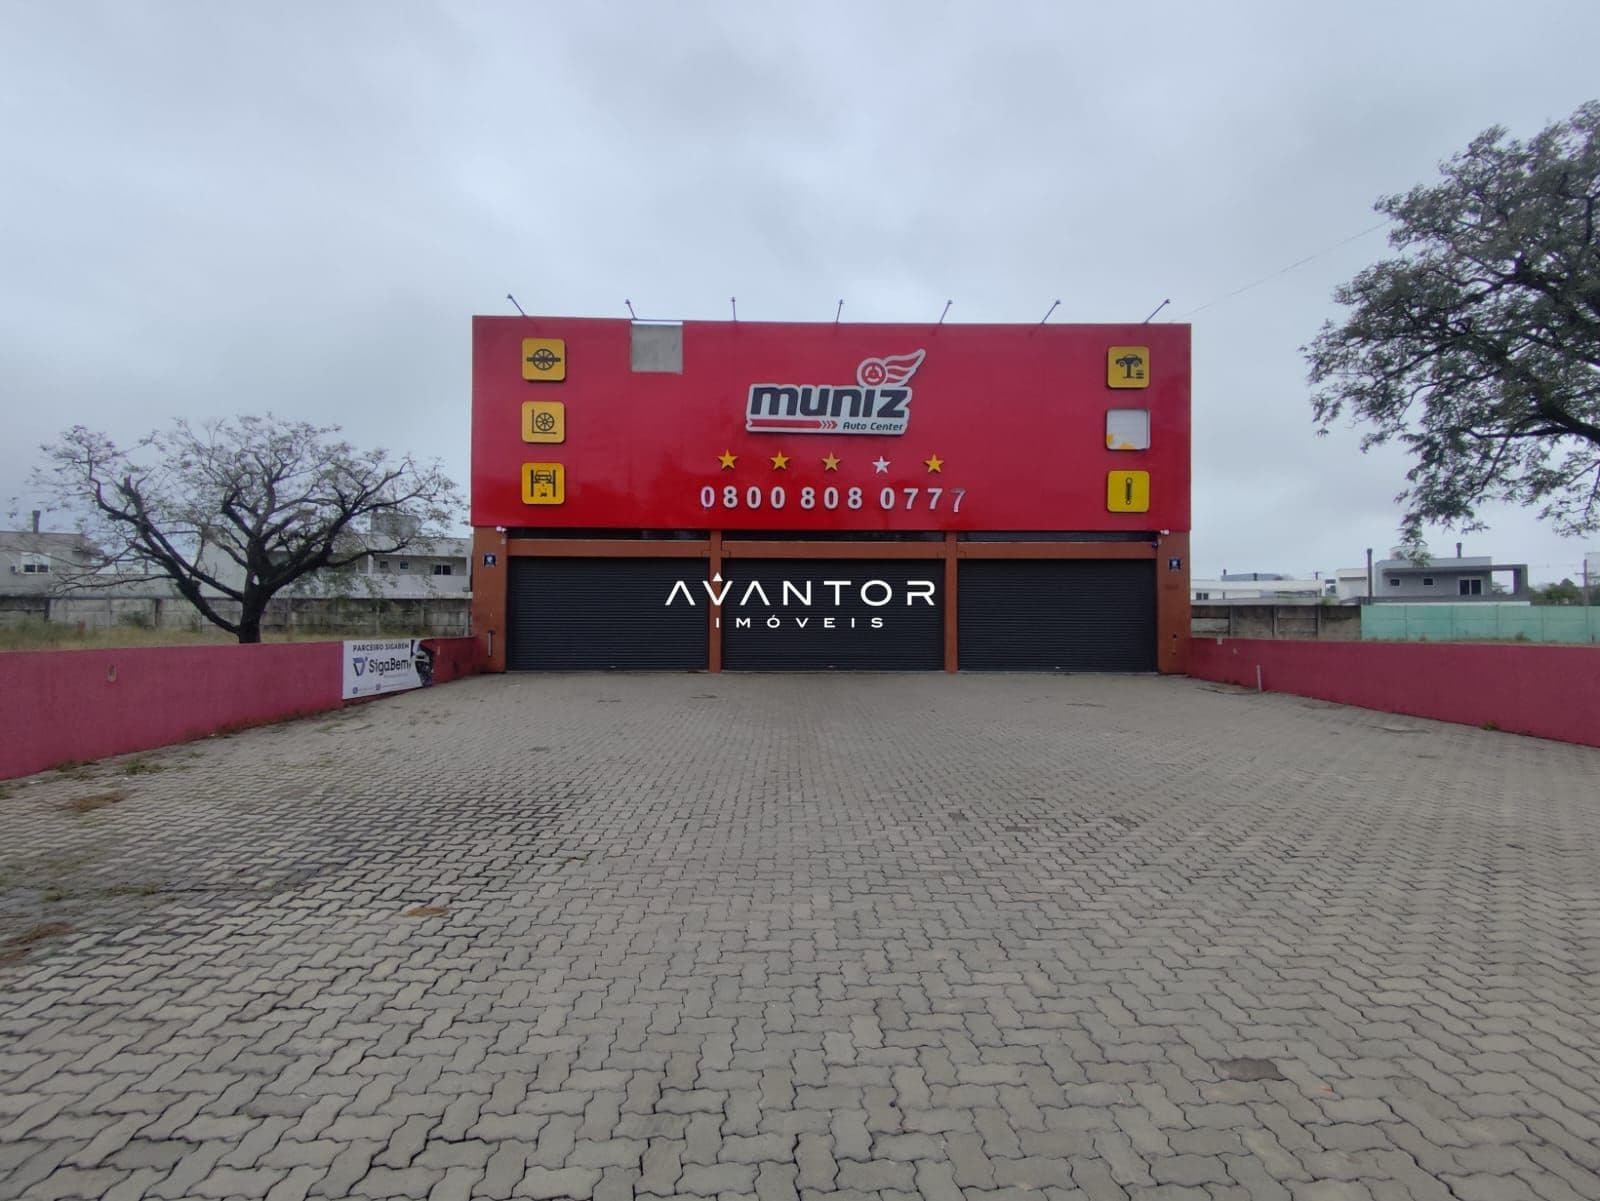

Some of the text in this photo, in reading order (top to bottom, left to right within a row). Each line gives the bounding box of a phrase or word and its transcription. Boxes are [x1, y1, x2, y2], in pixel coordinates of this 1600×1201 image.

[750, 386, 909, 418] muniz
[842, 421, 904, 432] Auto Center
[700, 485, 966, 513] 0800 808 0777
[352, 642, 410, 653] PARCEIRO SIGABEM
[368, 657, 409, 676] SigaBem
